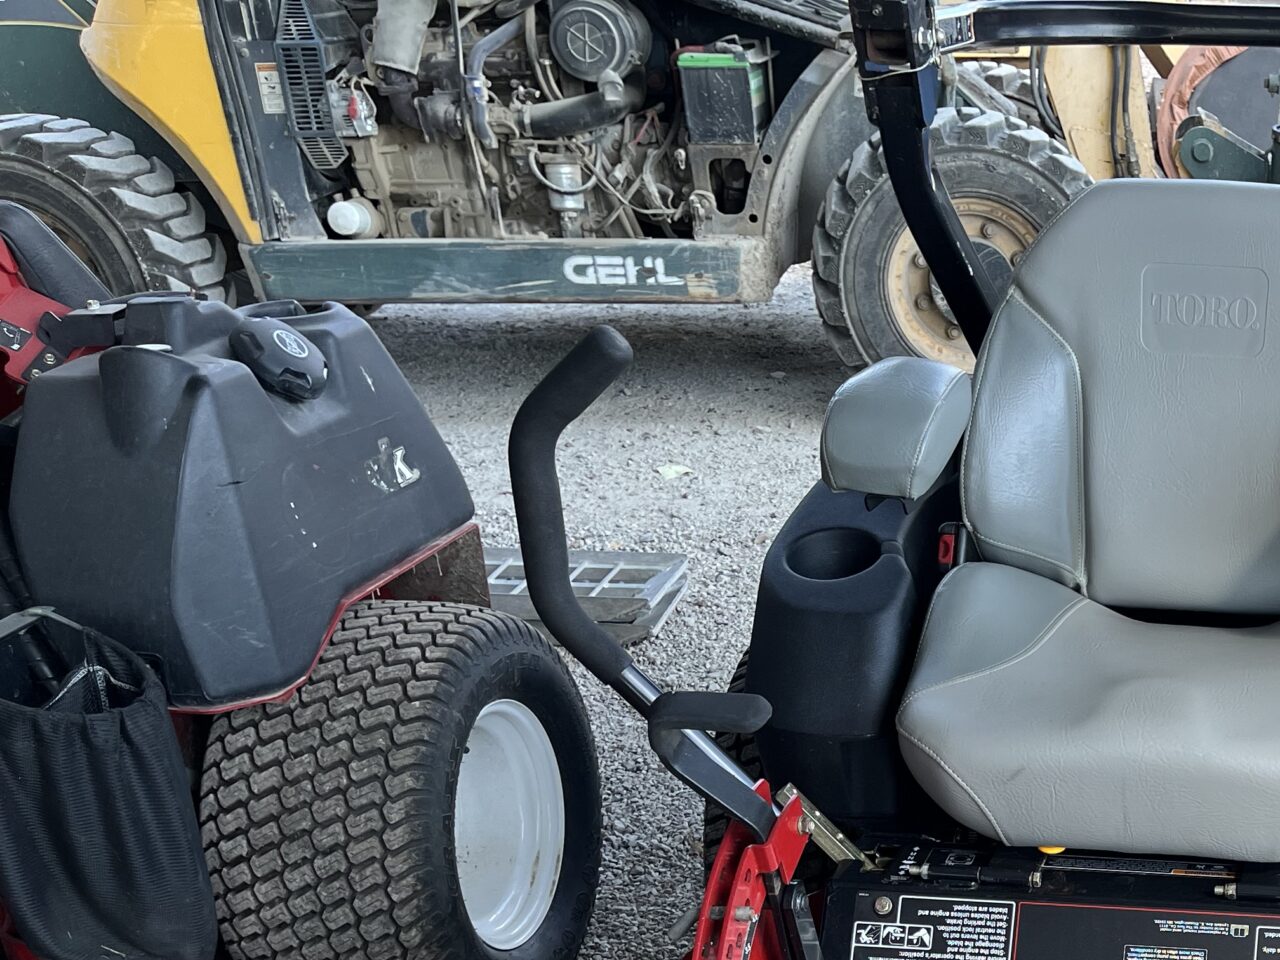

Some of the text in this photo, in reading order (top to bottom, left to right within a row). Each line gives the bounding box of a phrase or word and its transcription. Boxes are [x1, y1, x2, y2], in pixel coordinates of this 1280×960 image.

[563, 254, 686, 286] GEHL
[1150, 293, 1257, 329] TORO
[974, 940, 1004, 948] disengage
